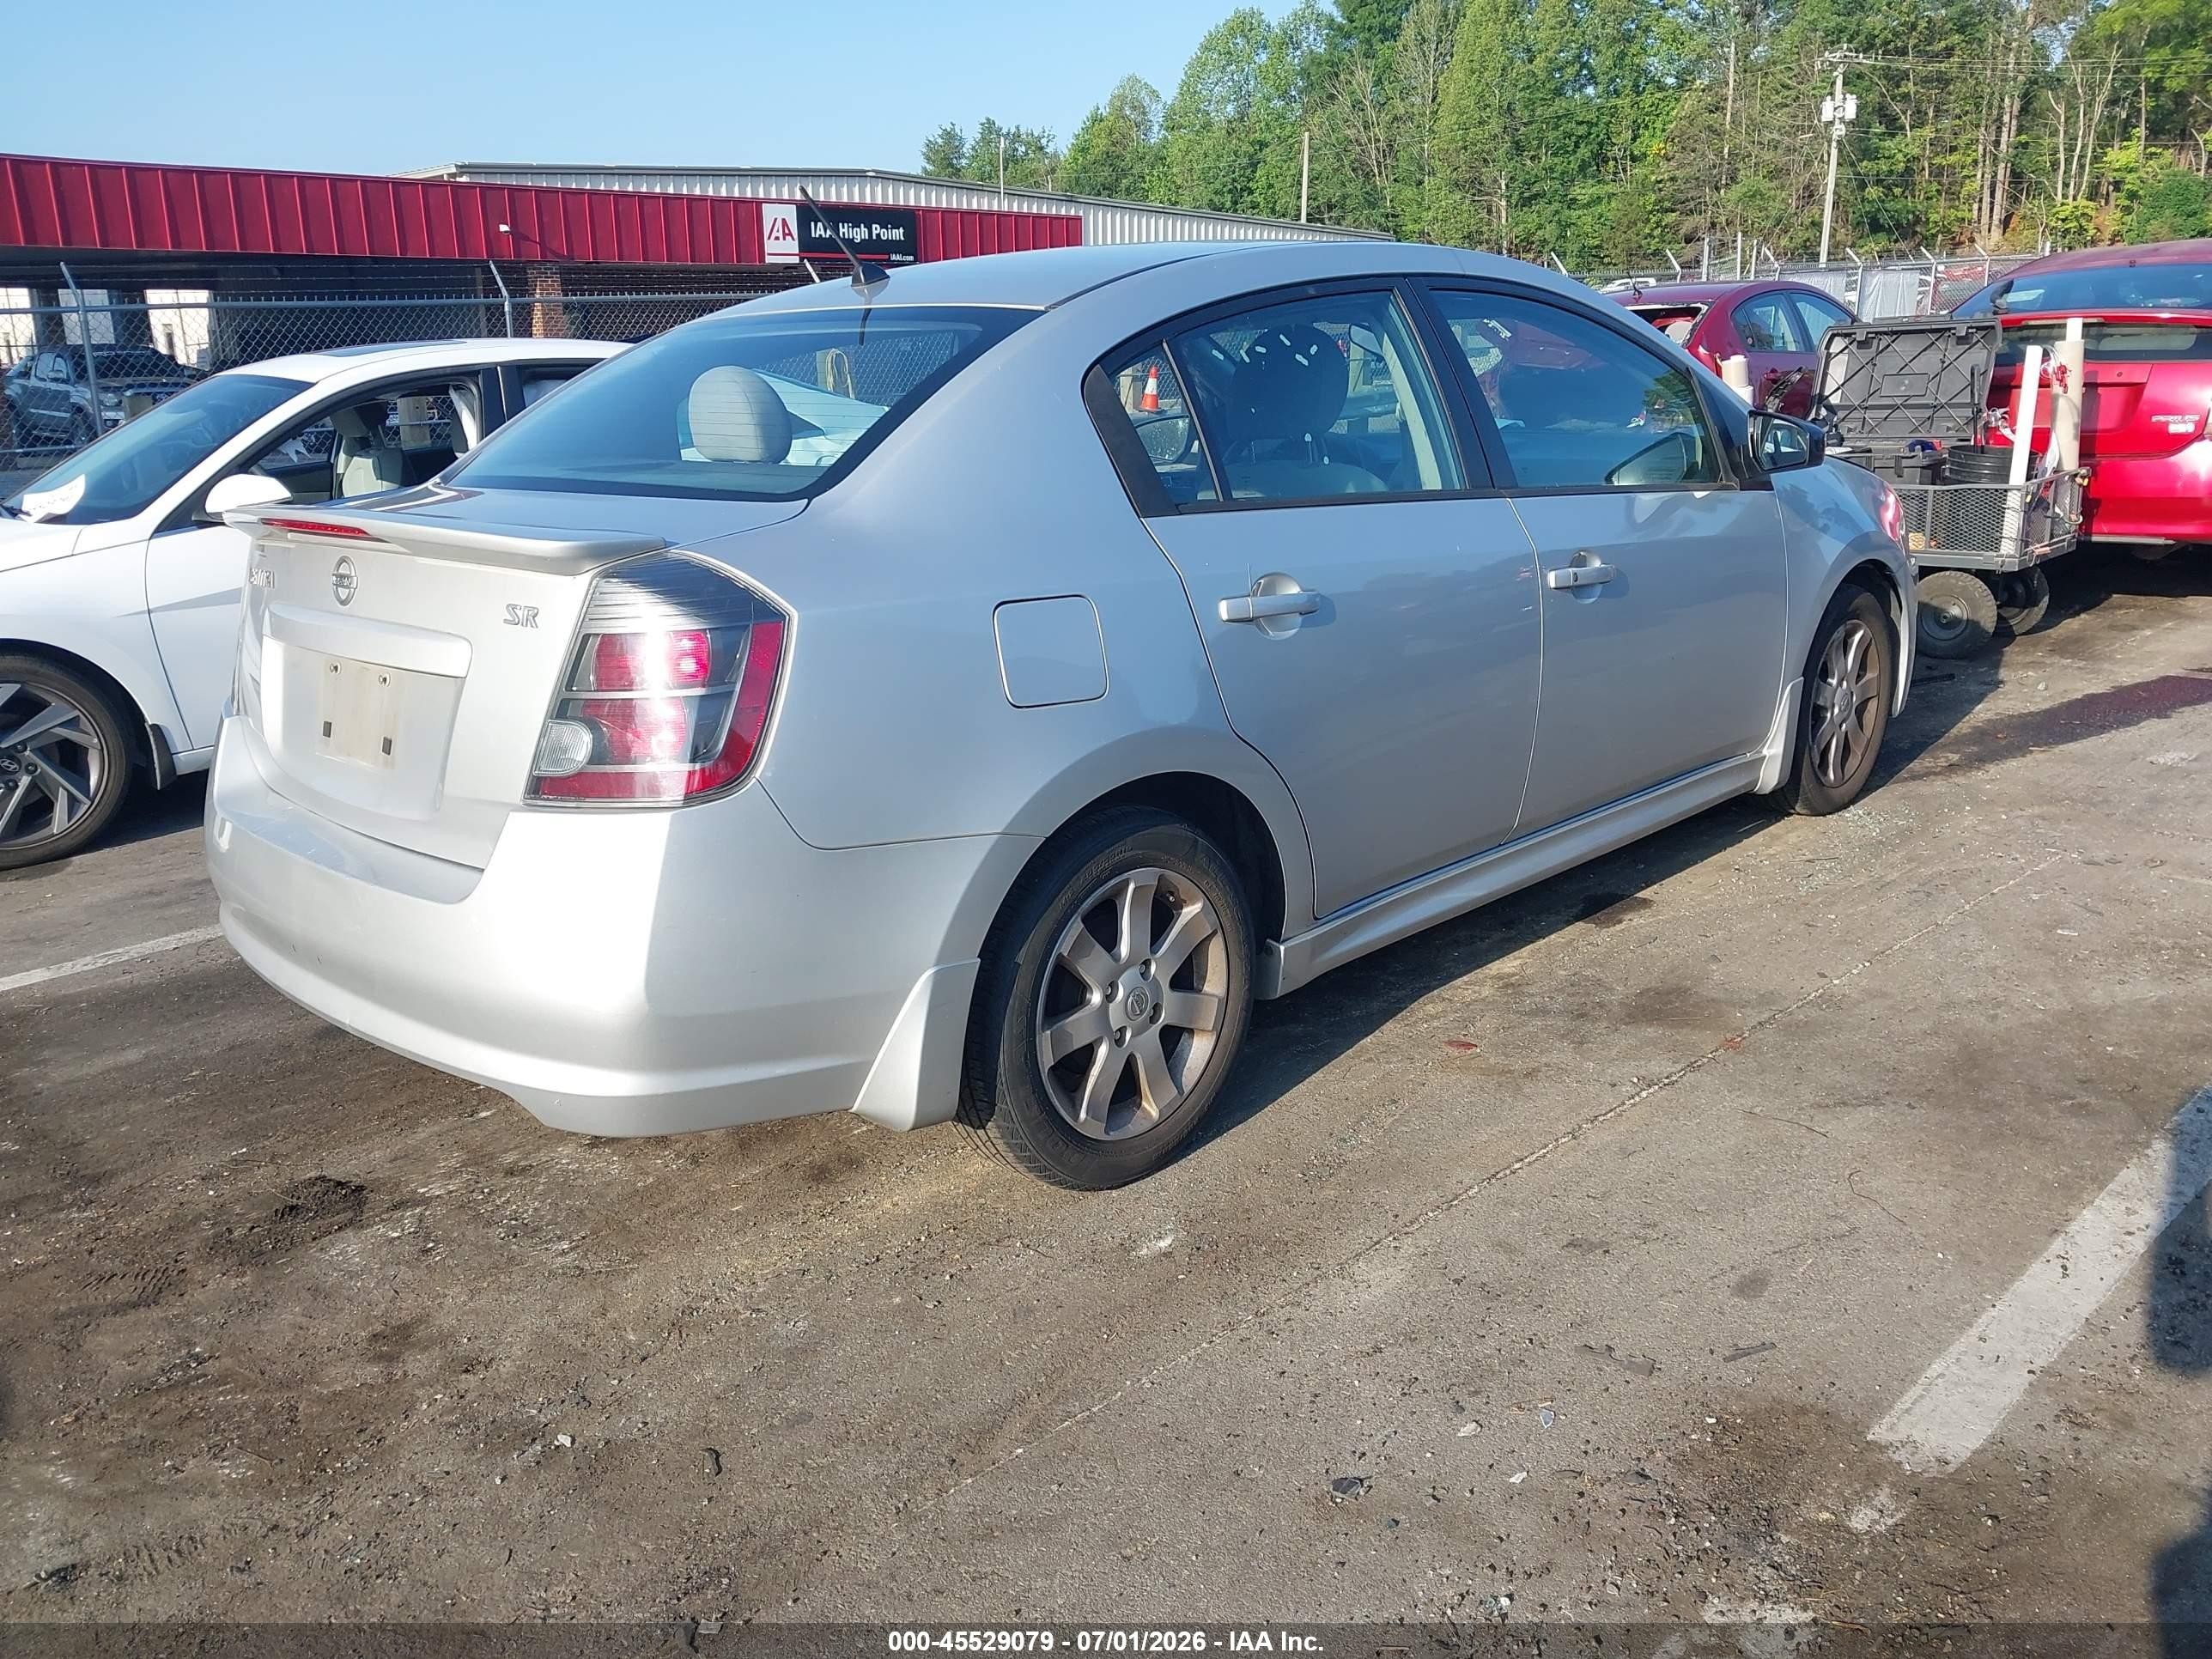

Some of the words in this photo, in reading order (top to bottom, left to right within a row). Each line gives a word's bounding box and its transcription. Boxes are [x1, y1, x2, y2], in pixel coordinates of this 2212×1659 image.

[811, 221, 836, 238] IAA
[839, 223, 869, 242] High
[872, 223, 905, 241] Point
[502, 603, 540, 629] SR
